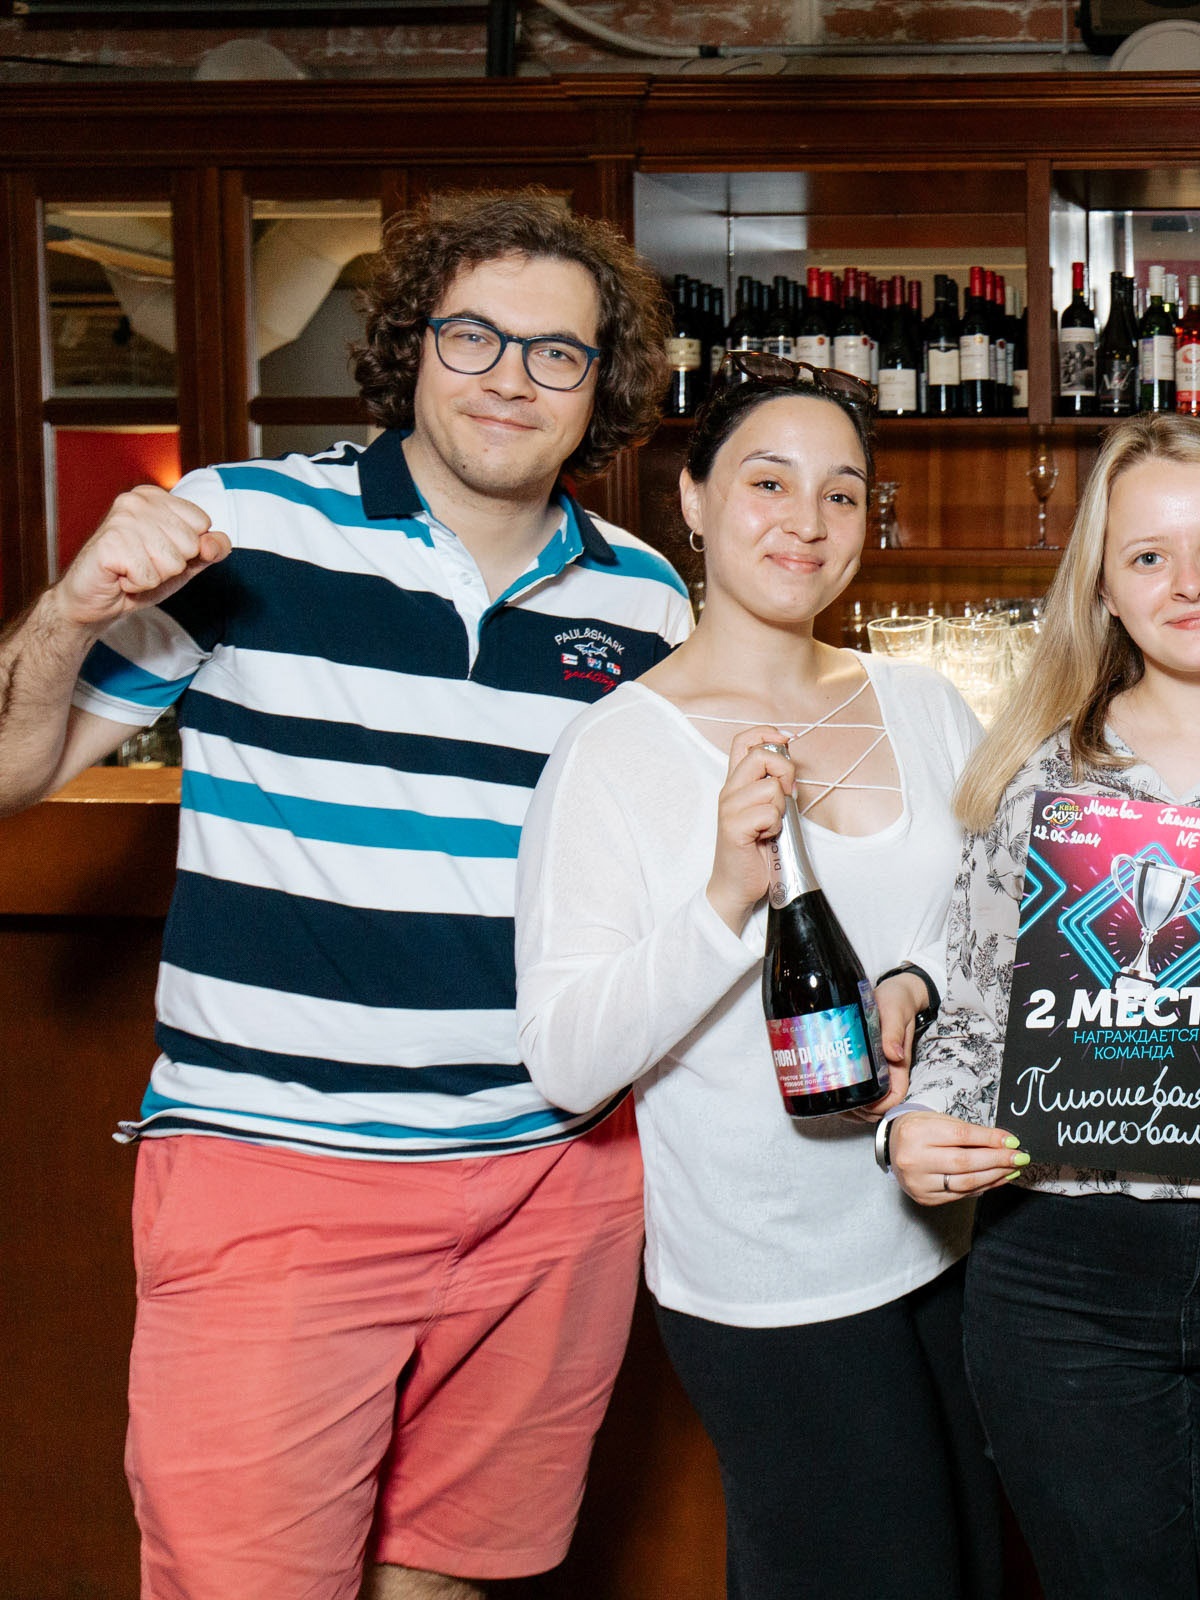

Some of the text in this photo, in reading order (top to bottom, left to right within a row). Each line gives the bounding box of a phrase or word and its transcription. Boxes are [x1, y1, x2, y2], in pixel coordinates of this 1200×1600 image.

[1042, 804, 1084, 823] Смузи
[1083, 799, 1143, 819] Москва
[1025, 988, 1056, 1029] 2
[1073, 1028, 1200, 1045] НАГРАЖДАЕТСЯ
[798, 1046, 813, 1065] DI
[1094, 1045, 1175, 1061] КОМАНДА
